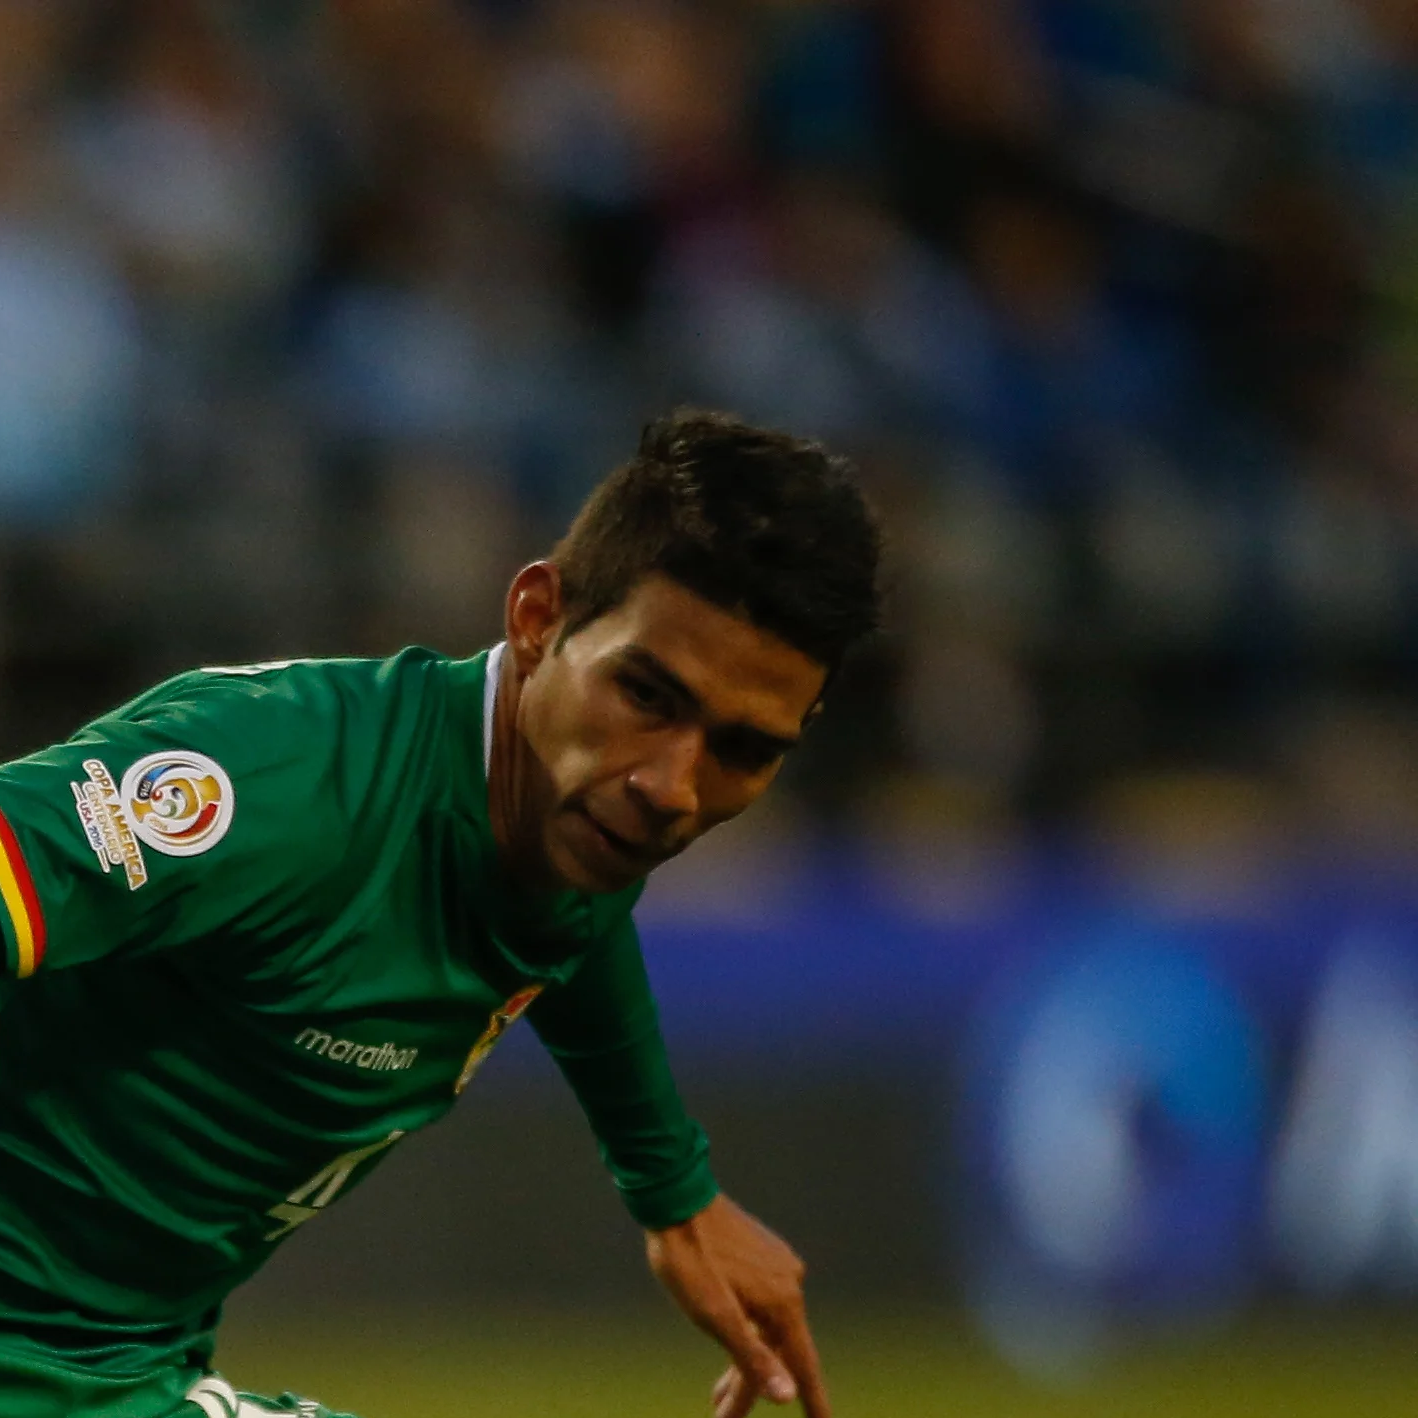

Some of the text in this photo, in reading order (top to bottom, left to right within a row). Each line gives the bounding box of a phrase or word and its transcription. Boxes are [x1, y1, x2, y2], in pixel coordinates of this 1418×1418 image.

[78, 802, 103, 849] USA 2016
[84, 784, 122, 862] CENTENARIO
[85, 760, 146, 889] COPA AMERICA
[294, 1027, 418, 1071] marathon
